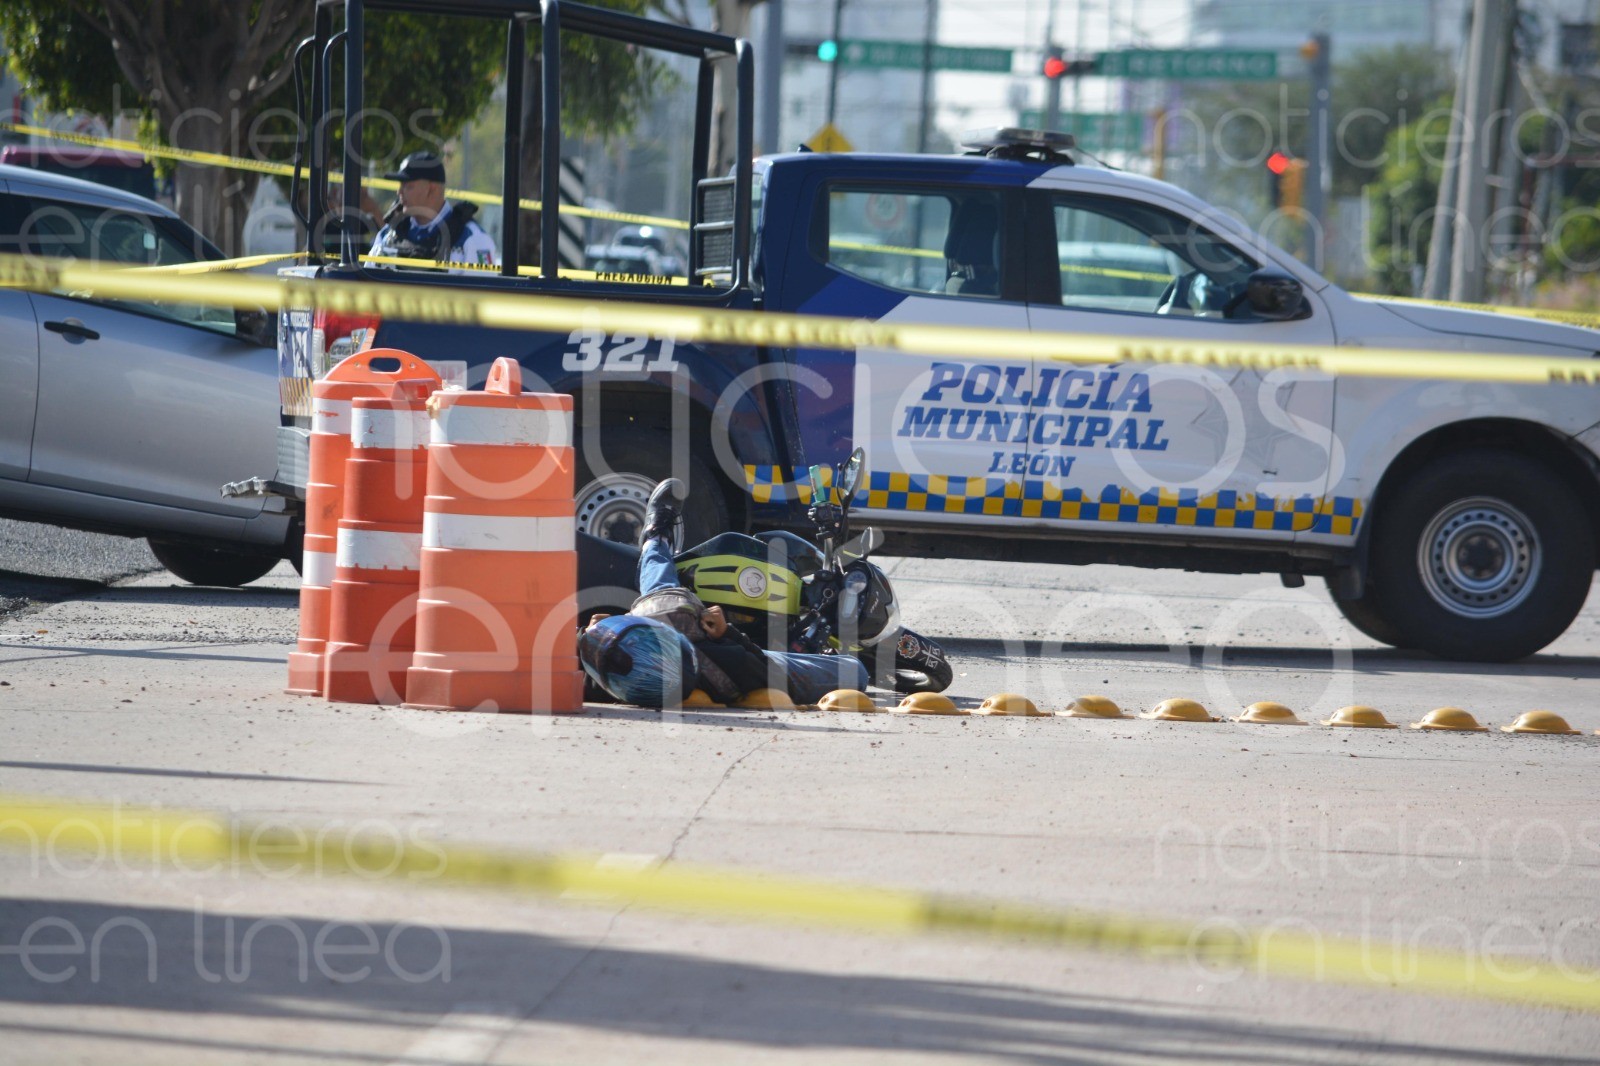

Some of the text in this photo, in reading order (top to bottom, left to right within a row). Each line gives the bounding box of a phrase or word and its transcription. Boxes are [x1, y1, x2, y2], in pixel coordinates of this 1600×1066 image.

[562, 328, 679, 372] 321
[922, 361, 1152, 413] POLICÍA
[897, 405, 1169, 451] MUNICIPAL
[988, 449, 1076, 477] LEÓN
